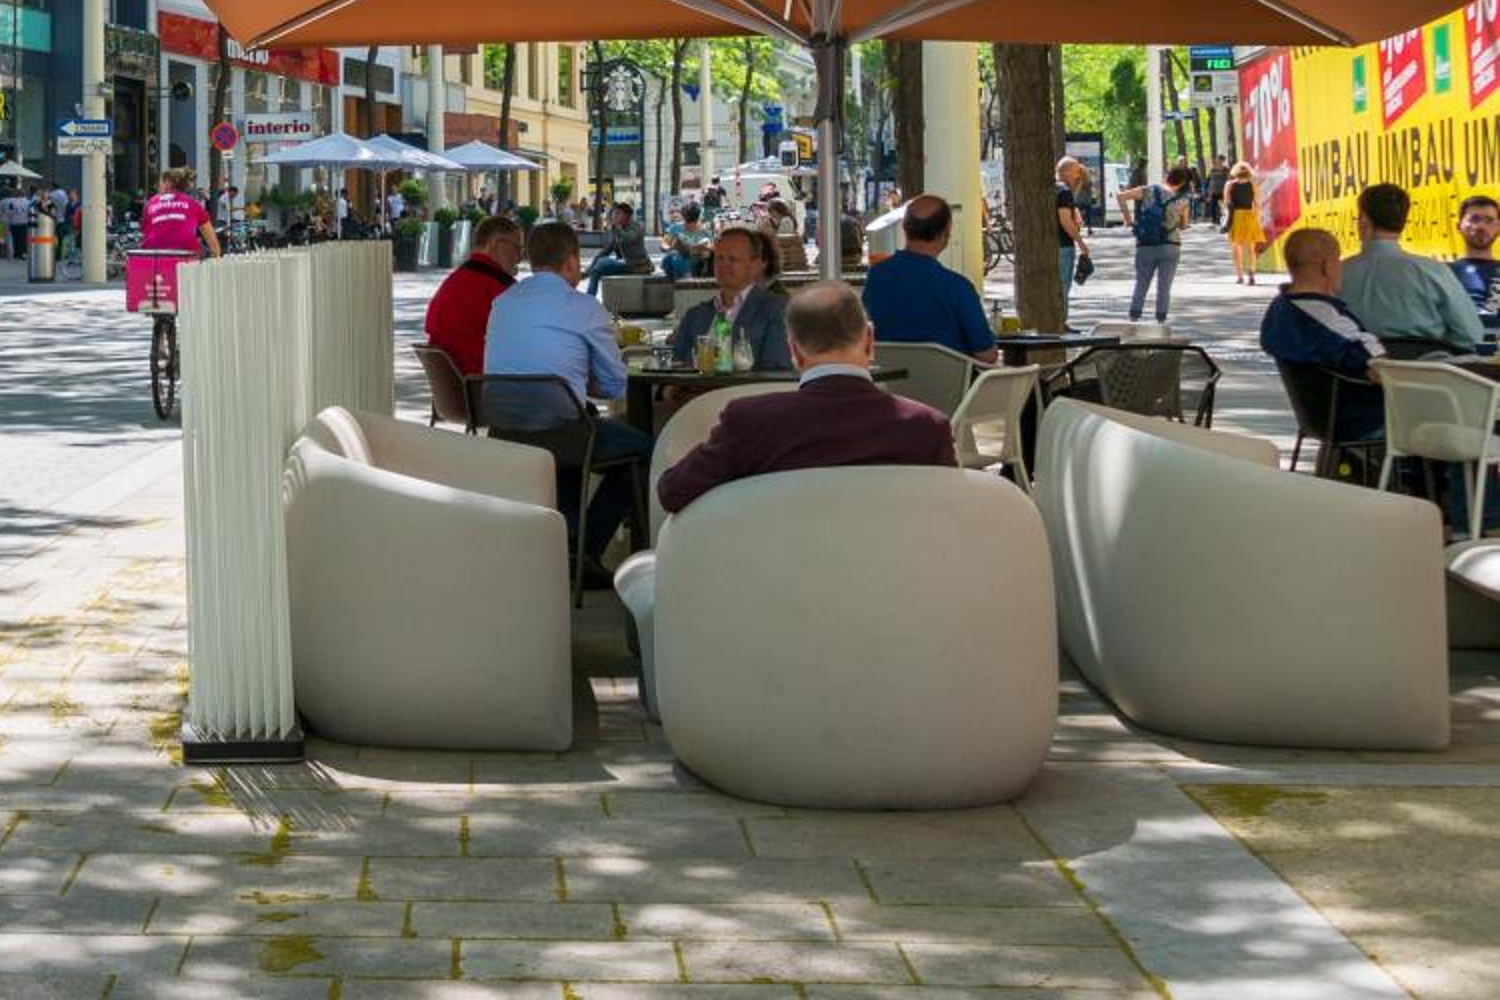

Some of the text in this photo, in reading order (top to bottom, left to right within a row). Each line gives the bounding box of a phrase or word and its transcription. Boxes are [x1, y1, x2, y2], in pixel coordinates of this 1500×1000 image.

[247, 120, 311, 135] interio
[1244, 55, 1292, 161] -70%
[1301, 129, 1369, 205] UMBAU
[1377, 116, 1454, 188] UMBAU
